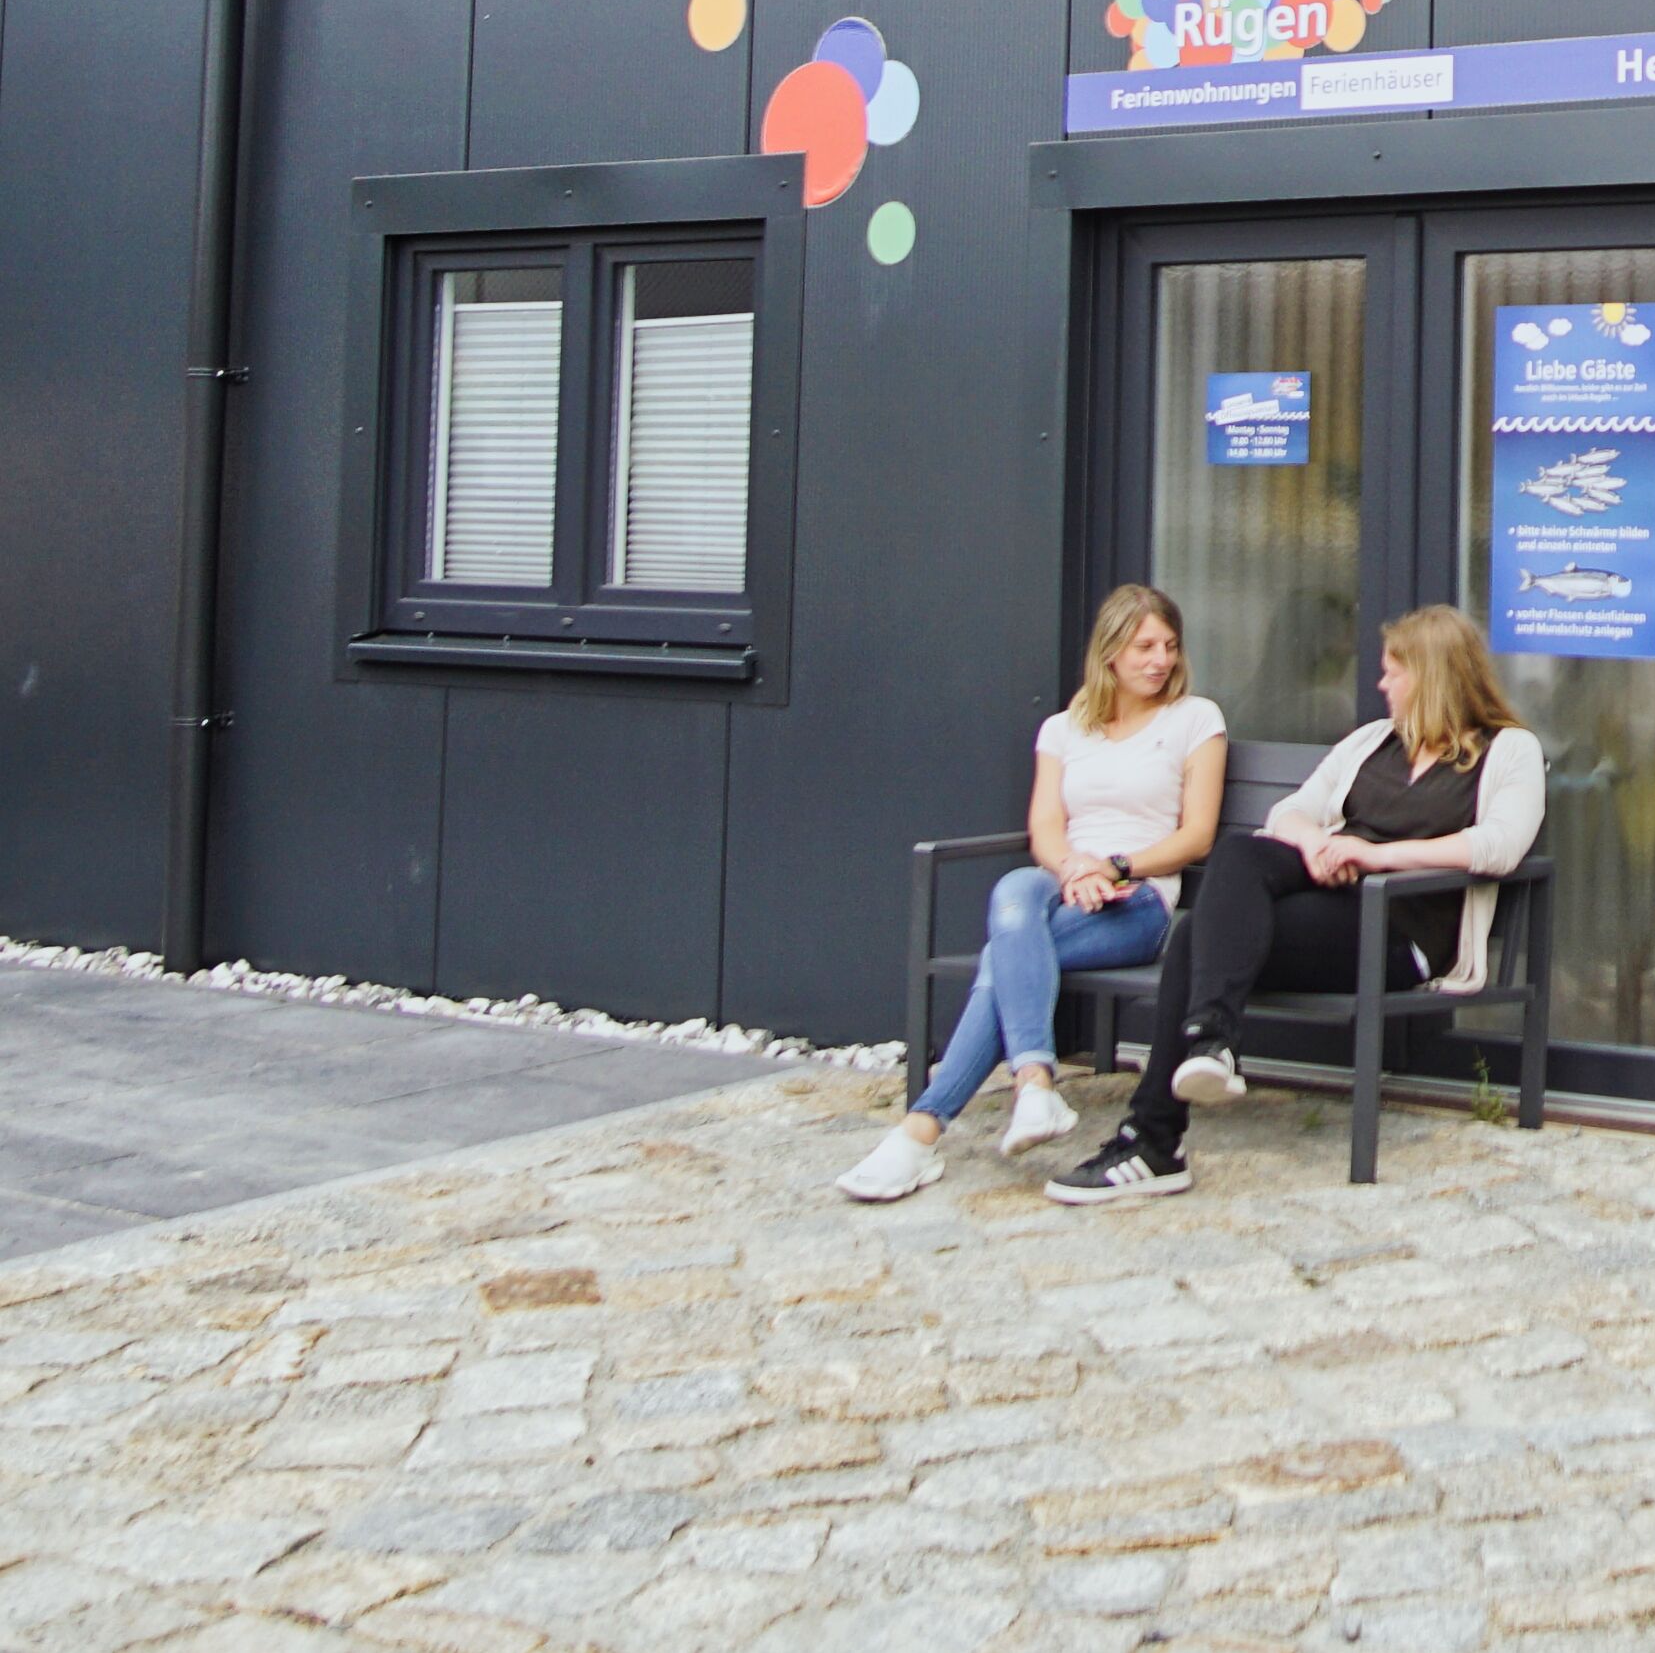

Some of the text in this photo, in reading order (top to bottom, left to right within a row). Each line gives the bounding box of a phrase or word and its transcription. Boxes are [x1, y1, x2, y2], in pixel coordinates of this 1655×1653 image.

[1110, 65, 1444, 112] Ferienwohnungen Ferienhäuser
[1525, 358, 1636, 381] Liebe Gäste
[1517, 525, 1650, 539] bitte keine Schwärme bilden
[1517, 540, 1617, 553] und einzeln eintreten
[1516, 609, 1647, 623] vorher Flossen desinfizieren
[1516, 623, 1634, 640] und Mundschutz anlegen
